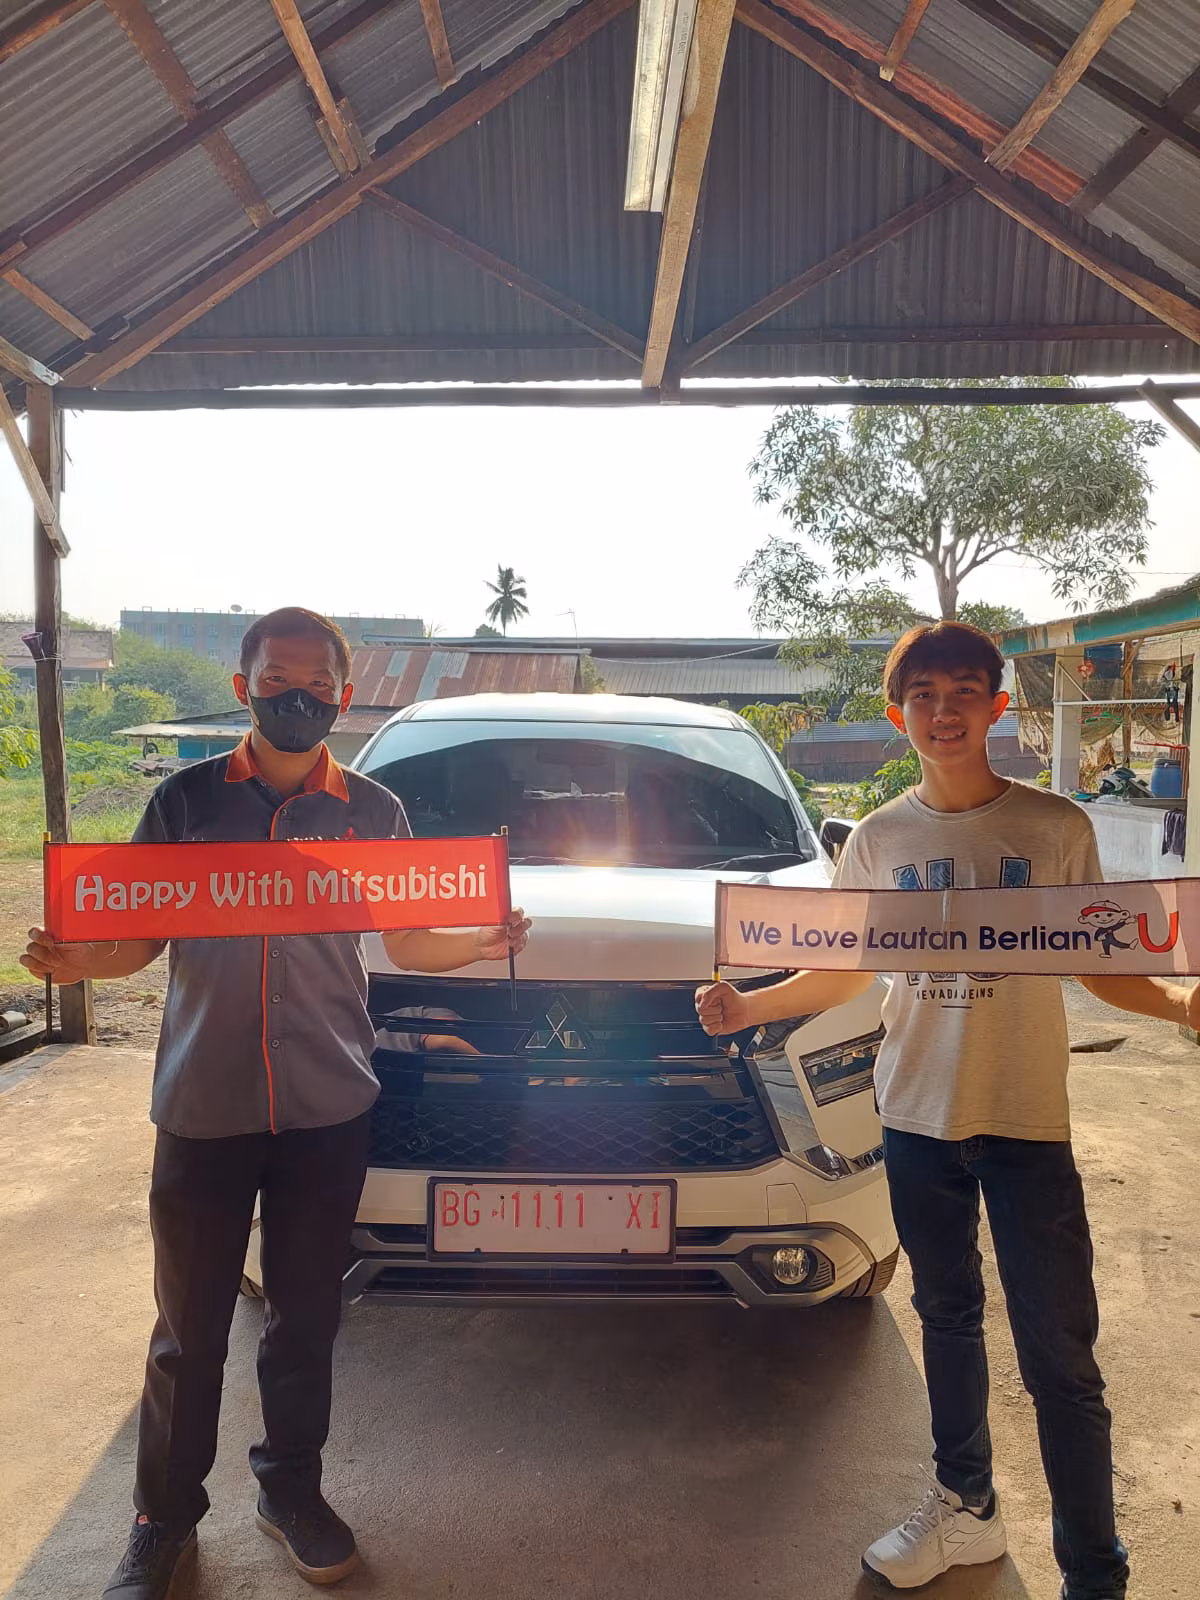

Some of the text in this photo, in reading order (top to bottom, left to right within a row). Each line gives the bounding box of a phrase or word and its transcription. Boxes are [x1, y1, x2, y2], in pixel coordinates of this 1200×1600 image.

[75, 864, 487, 912] Happy With Mitsubishi
[739, 920, 782, 945] We
[791, 923, 858, 949] Love
[866, 925, 968, 950] Lautan
[979, 925, 1093, 952] Berlian
[441, 1190, 661, 1229] BG 1111 XI
